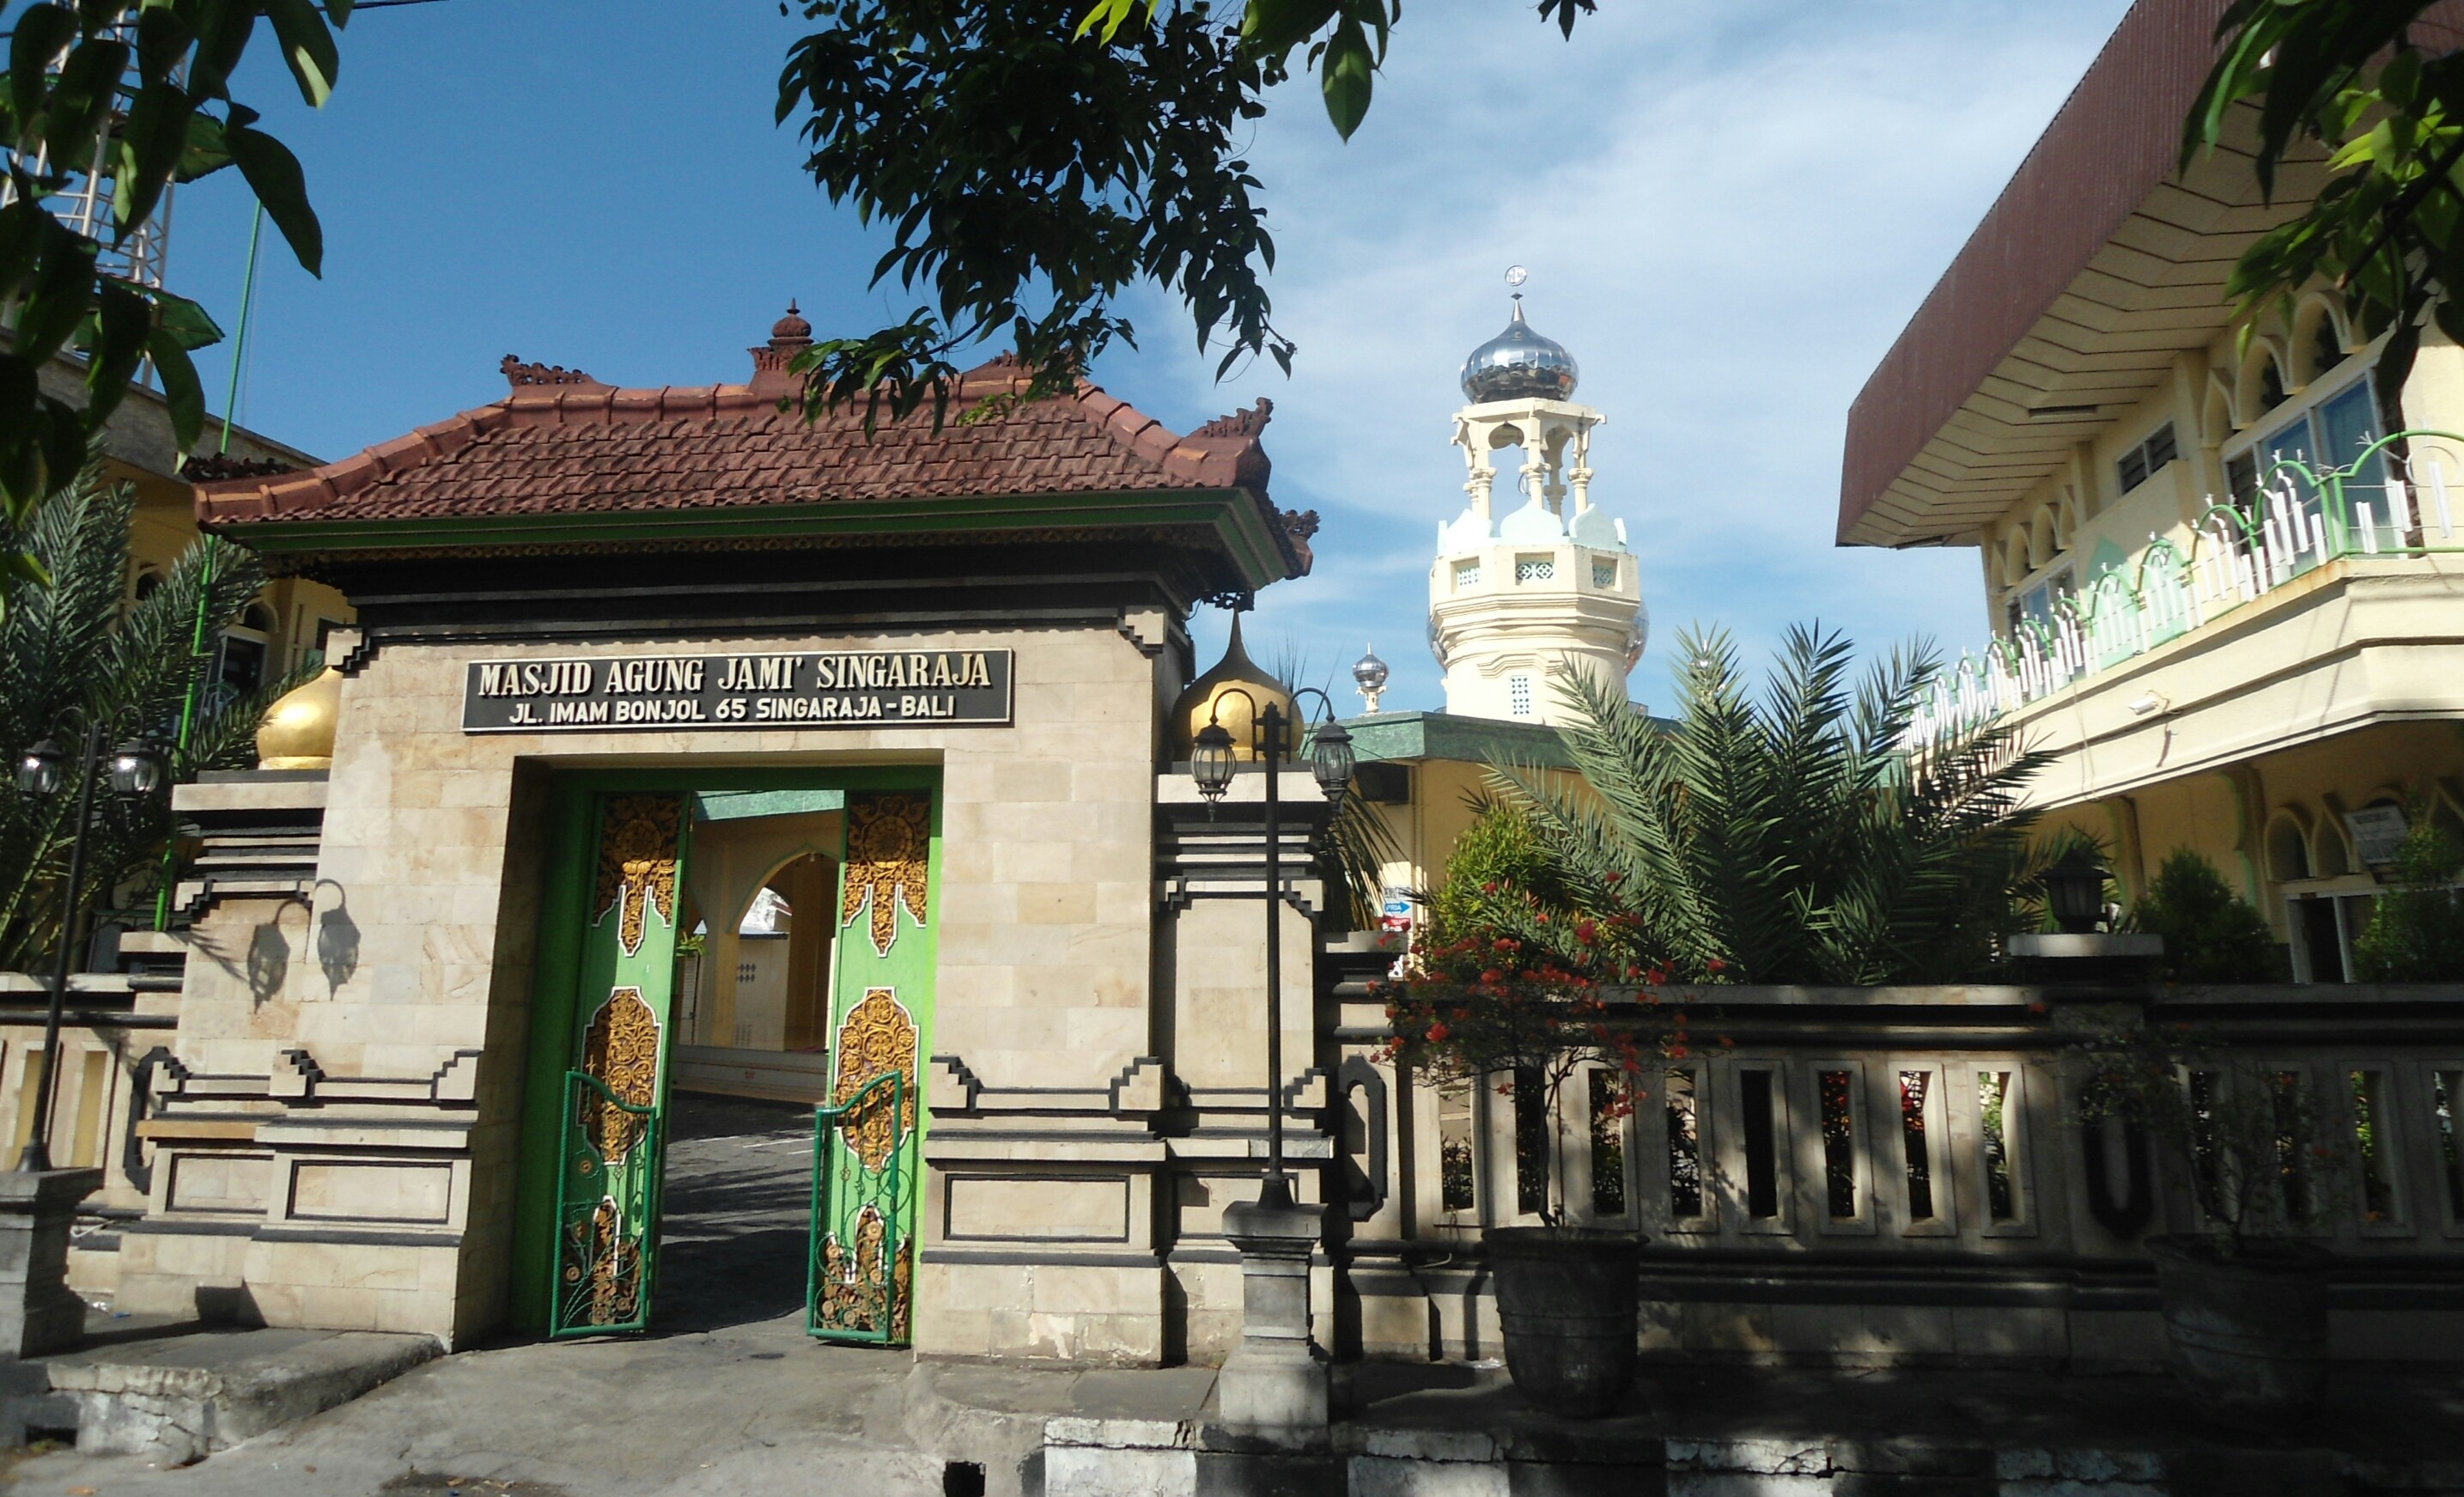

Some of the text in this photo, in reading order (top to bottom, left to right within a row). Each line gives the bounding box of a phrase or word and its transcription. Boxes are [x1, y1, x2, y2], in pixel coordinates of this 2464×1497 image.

[478, 653, 991, 697] MASJID AGUNG JAMI' SINGARAJA
[508, 703, 544, 724] JL.
[550, 702, 609, 723] IMAM
[615, 699, 707, 721] BONJOL
[715, 698, 747, 719] 65
